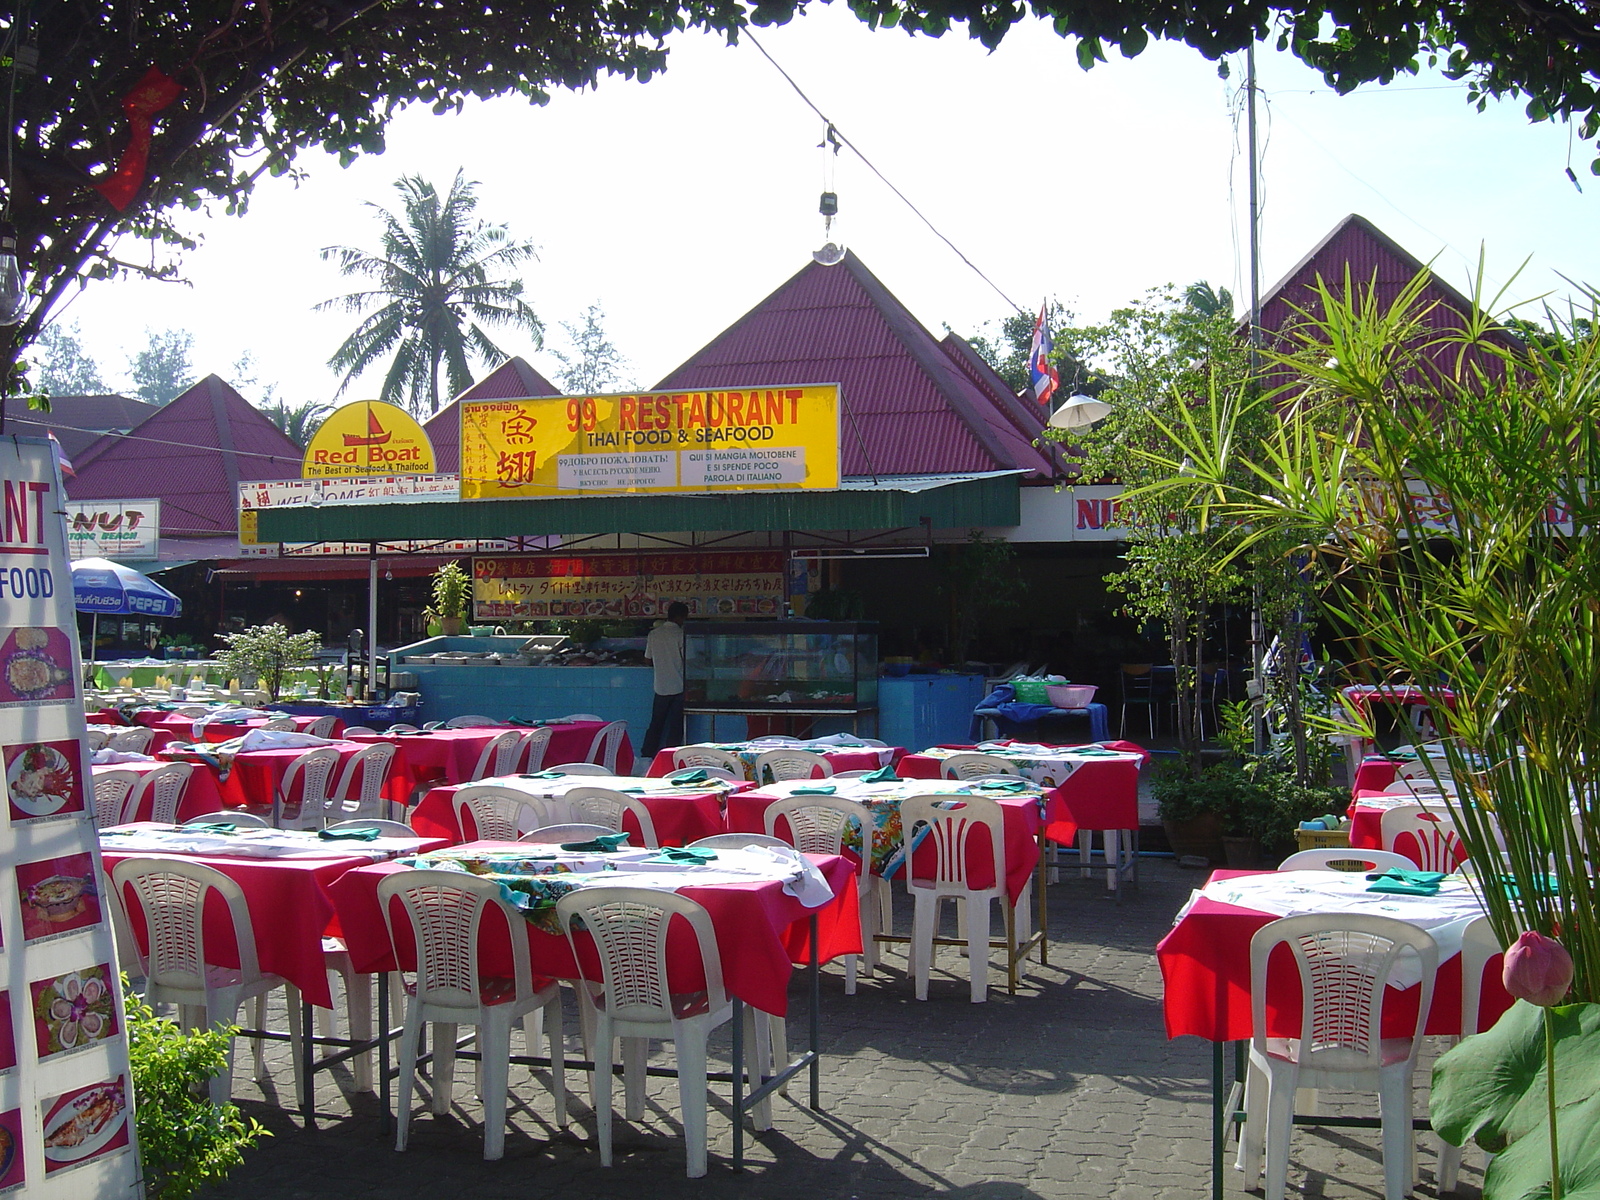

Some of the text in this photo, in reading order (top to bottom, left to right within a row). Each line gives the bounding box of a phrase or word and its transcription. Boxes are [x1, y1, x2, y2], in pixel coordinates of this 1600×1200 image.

[566, 389, 803, 433] 99 RESTAURANT
[587, 426, 774, 447] THAI FOOD & SEAFOOD
[314, 446, 420, 465] Red Boat
[600, 454, 669, 465] ПОЖАЛОВАТЬ!
[689, 450, 797, 462] QUI SI MANGIA MOLTOBENE
[308, 467, 321, 475] The
[325, 466, 342, 475] Best
[355, 464, 386, 473] Seafood
[395, 462, 429, 471] Thaifood
[609, 467, 638, 475] РУССКОЕ
[713, 463, 720, 471] SI
[722, 463, 751, 471] SPENDE
[753, 462, 779, 470] POCO
[703, 474, 734, 482] PAROLA
[746, 473, 782, 481] ITALIANO
[277, 488, 365, 506] WELOME
[0, 480, 50, 544] NT
[66, 510, 145, 532] NUT
[68, 531, 137, 540] TONG BEACH
[128, 596, 168, 612] PEPSI
